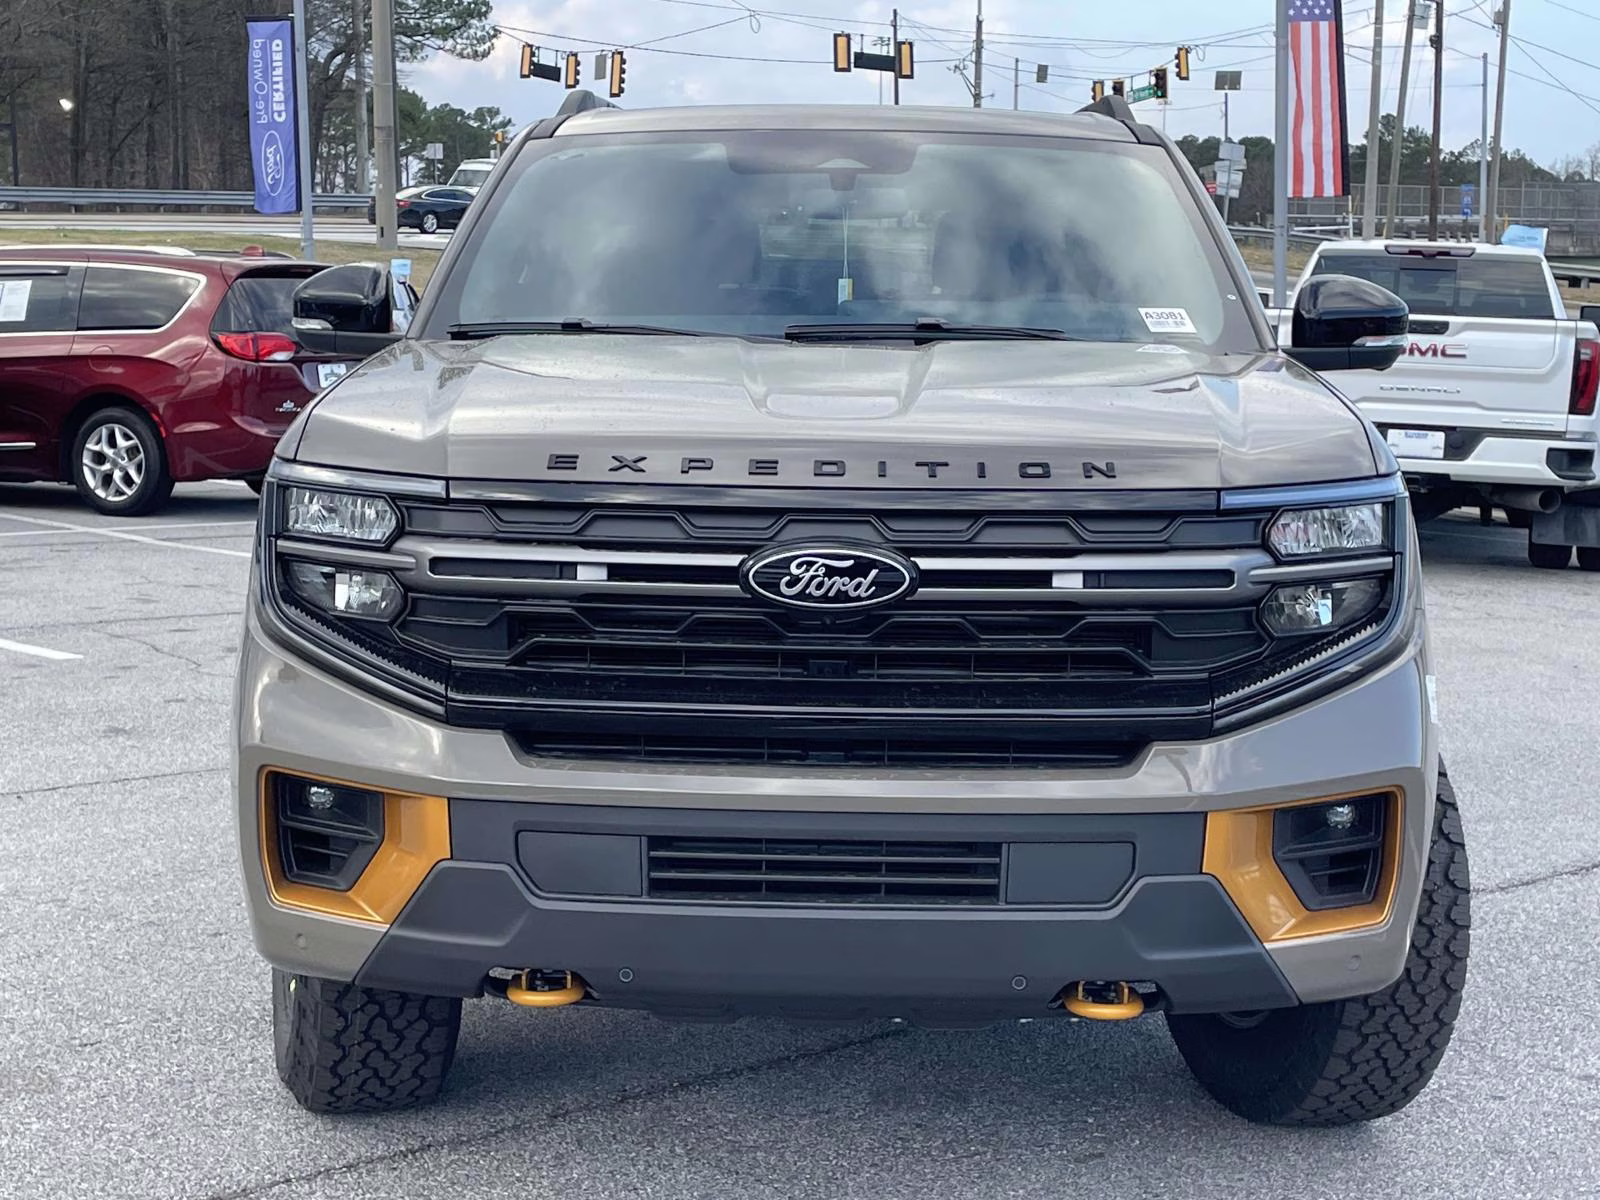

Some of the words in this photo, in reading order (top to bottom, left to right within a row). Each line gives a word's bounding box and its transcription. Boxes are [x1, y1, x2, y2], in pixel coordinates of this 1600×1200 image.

[1144, 311, 1186, 321] A3081
[1398, 342, 1468, 359] MC
[546, 453, 1117, 479] EXPEDITION
[779, 556, 879, 598] Ford
